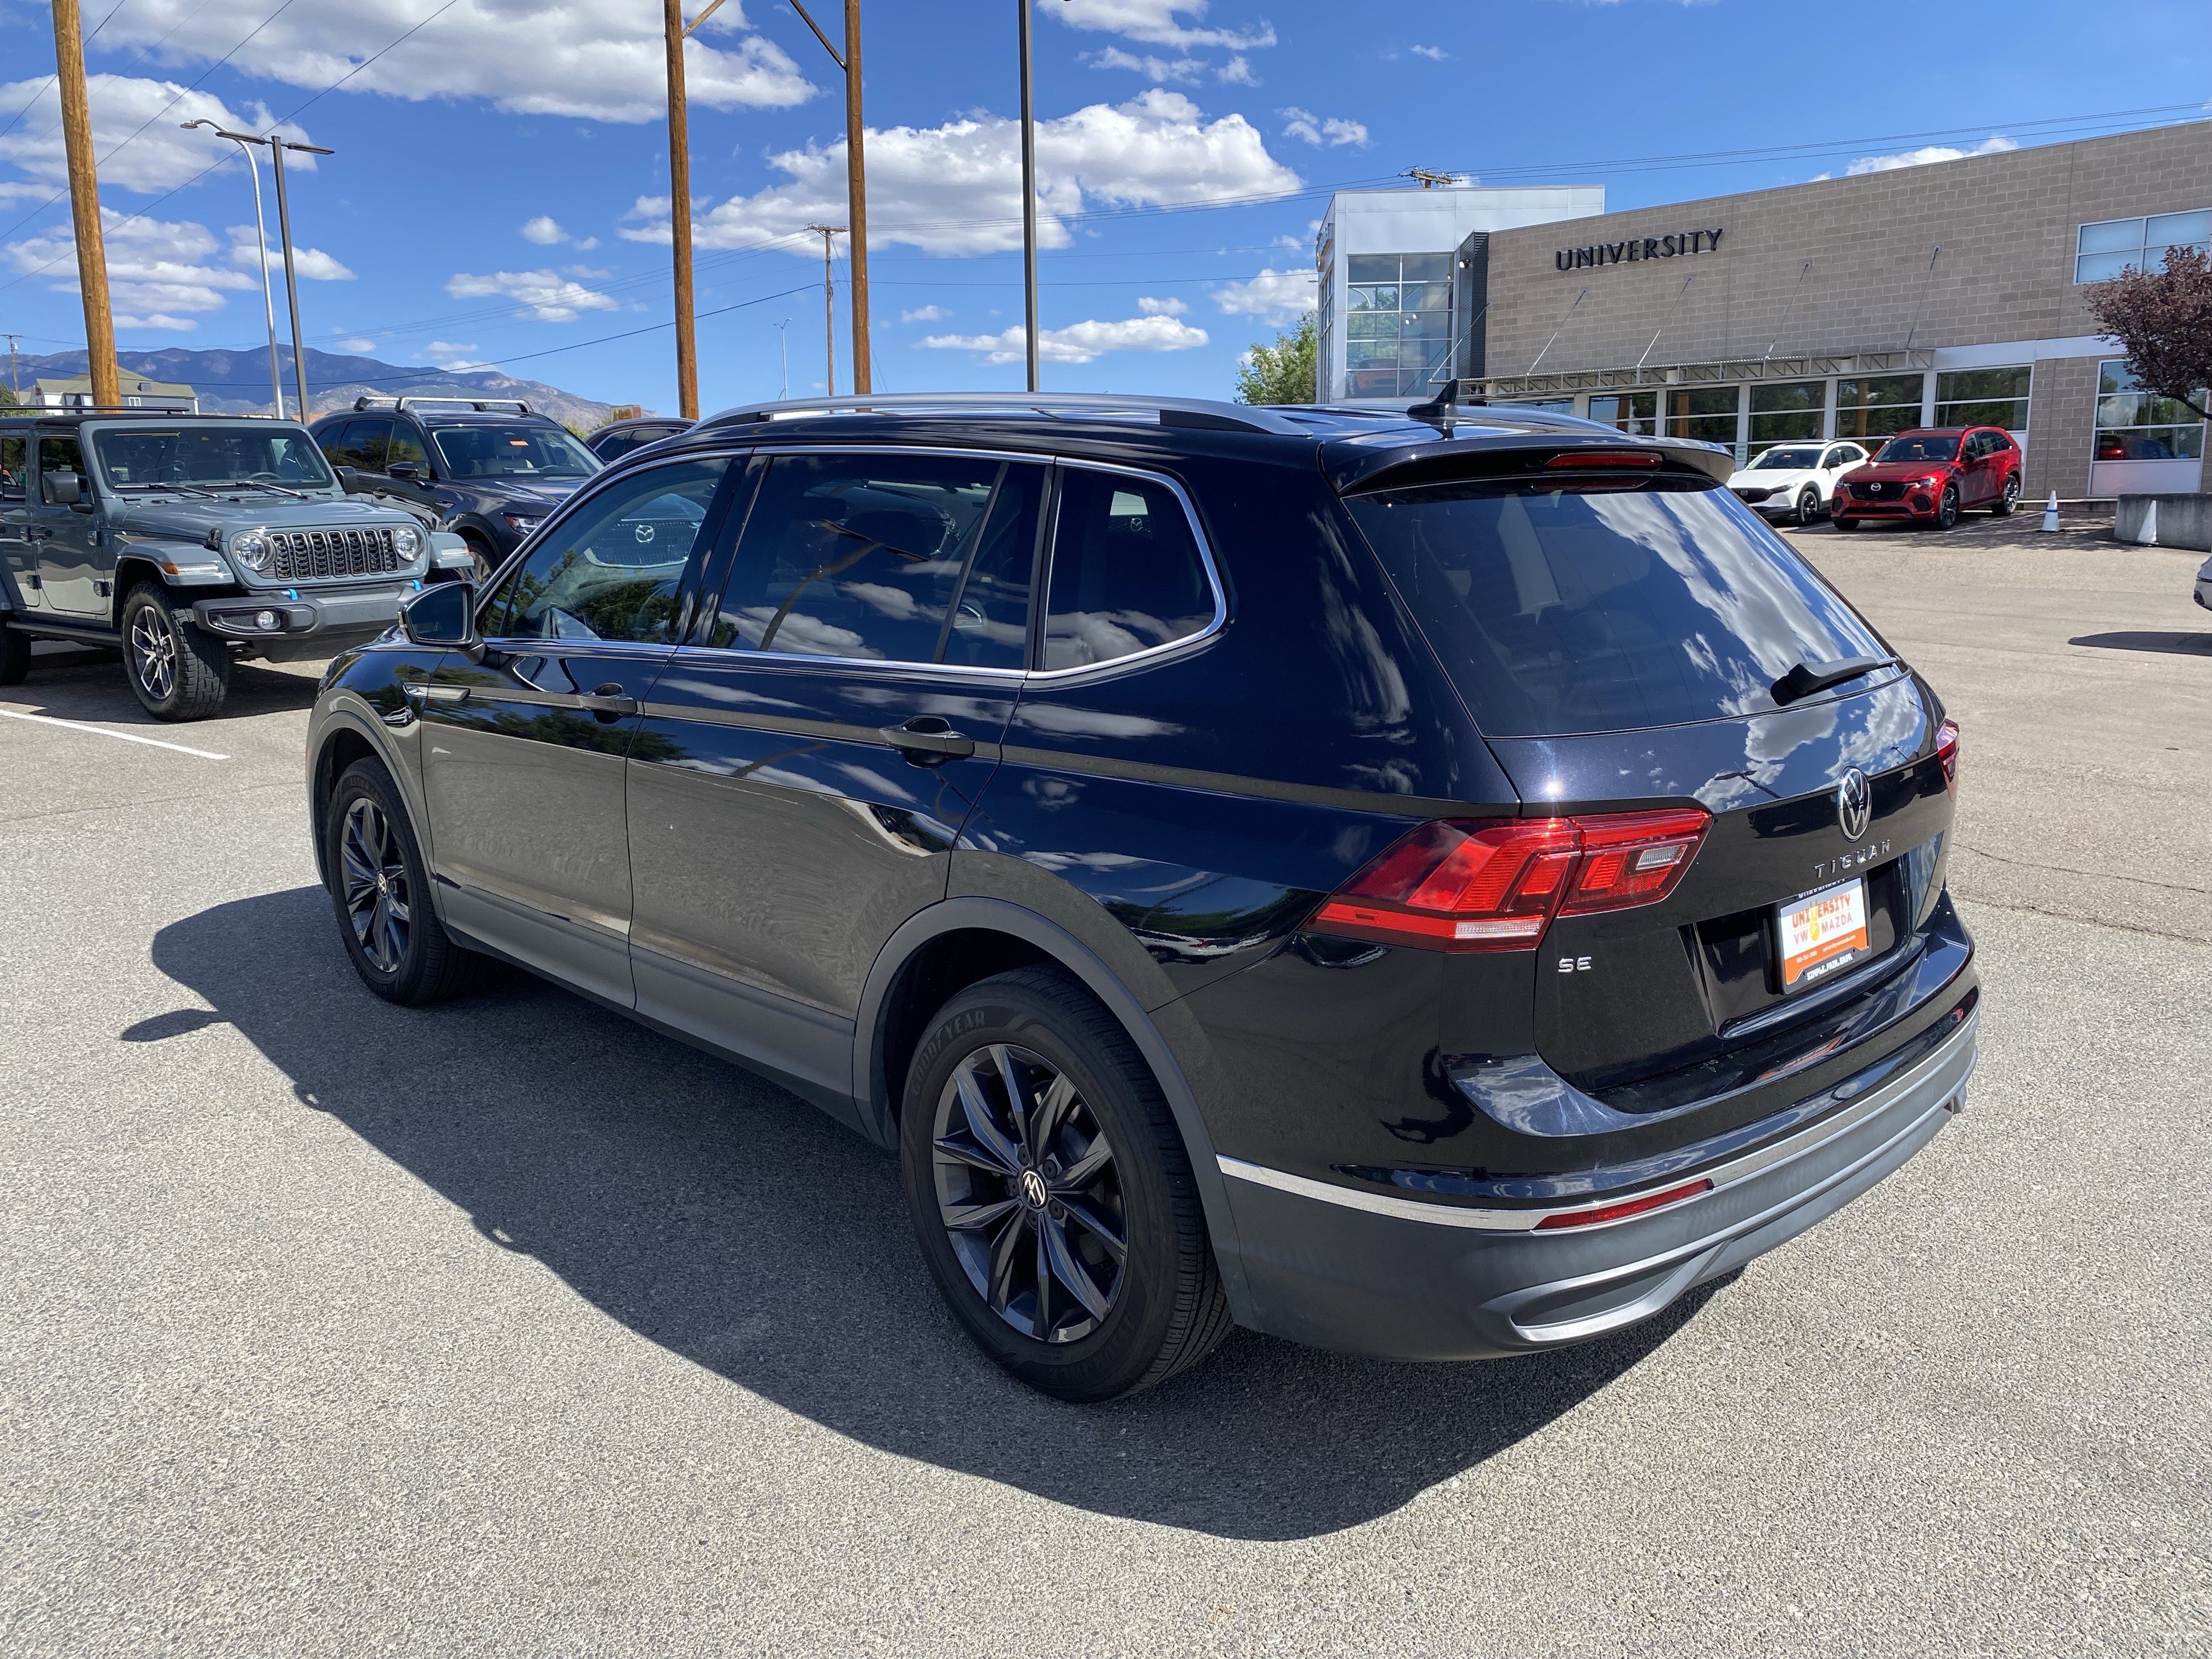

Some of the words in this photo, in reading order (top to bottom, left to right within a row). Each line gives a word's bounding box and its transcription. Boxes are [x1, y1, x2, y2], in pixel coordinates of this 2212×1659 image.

[1556, 228, 1724, 271] UNIVERSITY
[1814, 839, 1891, 878] TIGUAN
[1794, 929, 1808, 945] VW
[1821, 912, 1853, 934] MAZDA
[1558, 956, 1592, 972] SE
